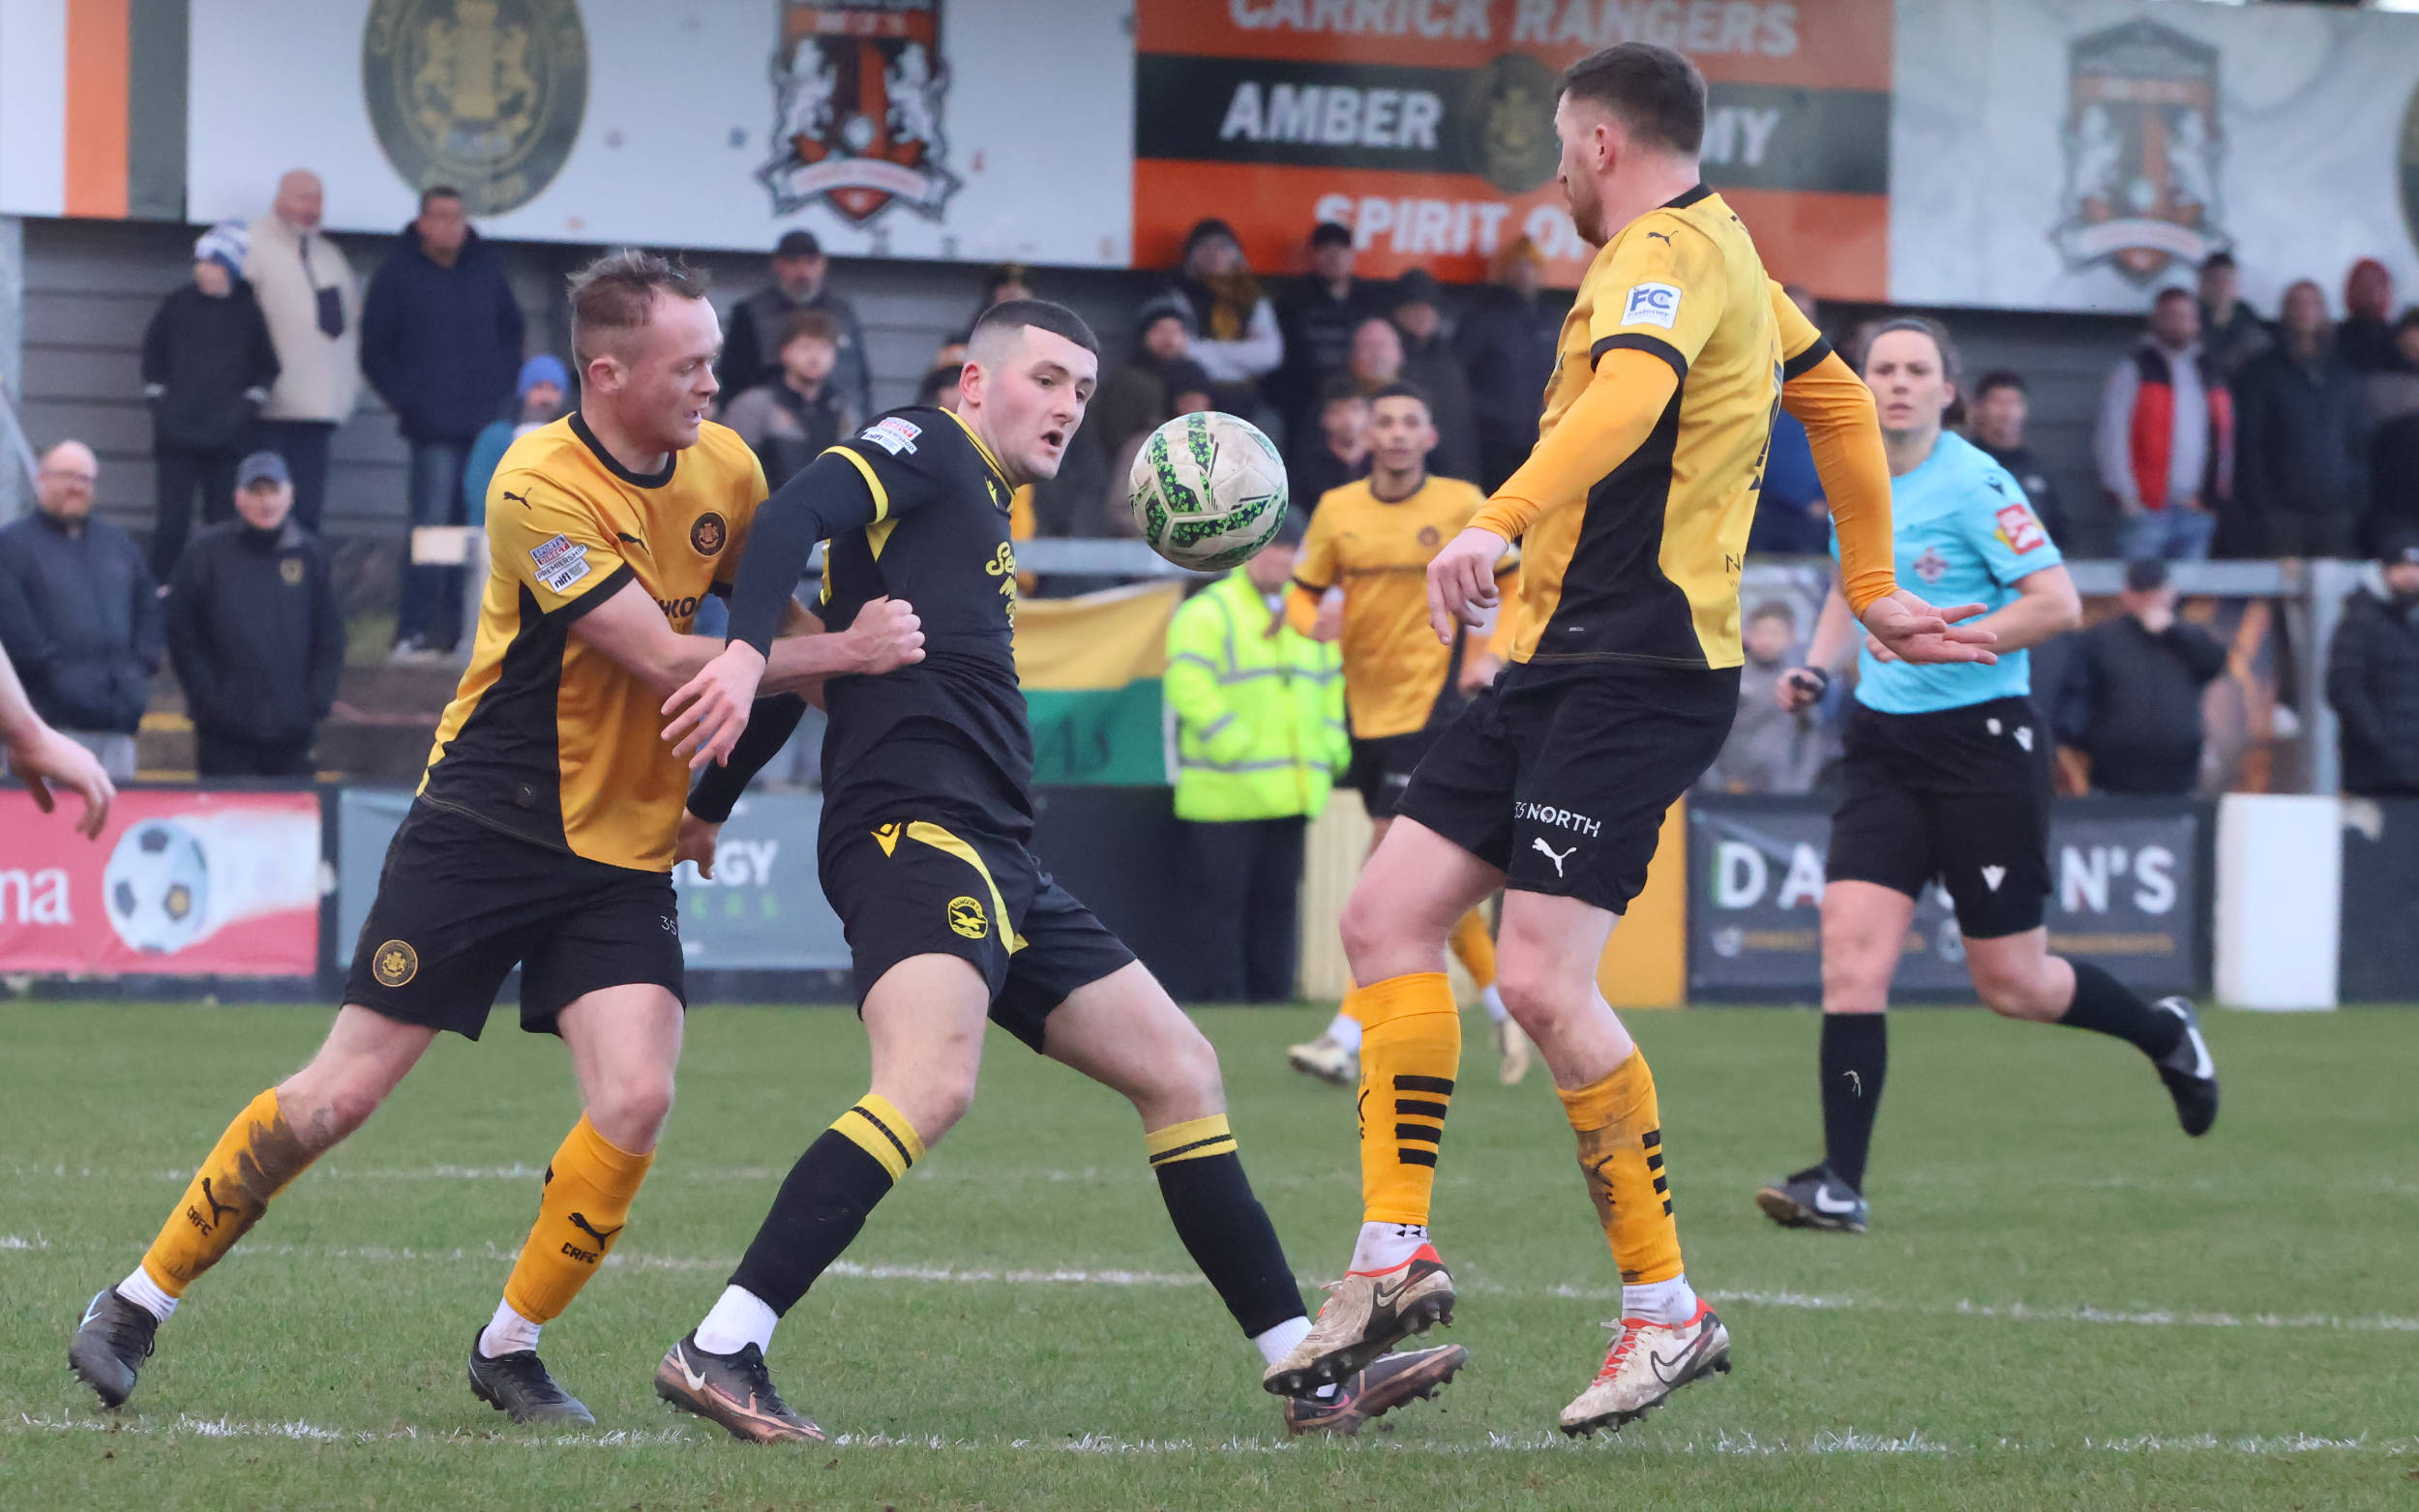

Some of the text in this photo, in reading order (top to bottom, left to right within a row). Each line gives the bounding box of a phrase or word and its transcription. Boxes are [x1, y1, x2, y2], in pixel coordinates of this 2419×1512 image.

[1511, 0, 1800, 57] RANGERS
[1219, 81, 1780, 167] AMBER MY
[1629, 288, 1673, 311] FC
[534, 537, 562, 557] SPORTS
[539, 544, 568, 565] DIRECT
[536, 545, 585, 579] PREMIERSHIP
[1527, 802, 1601, 838] NORTH
[561, 1242, 598, 1263] CRFC
